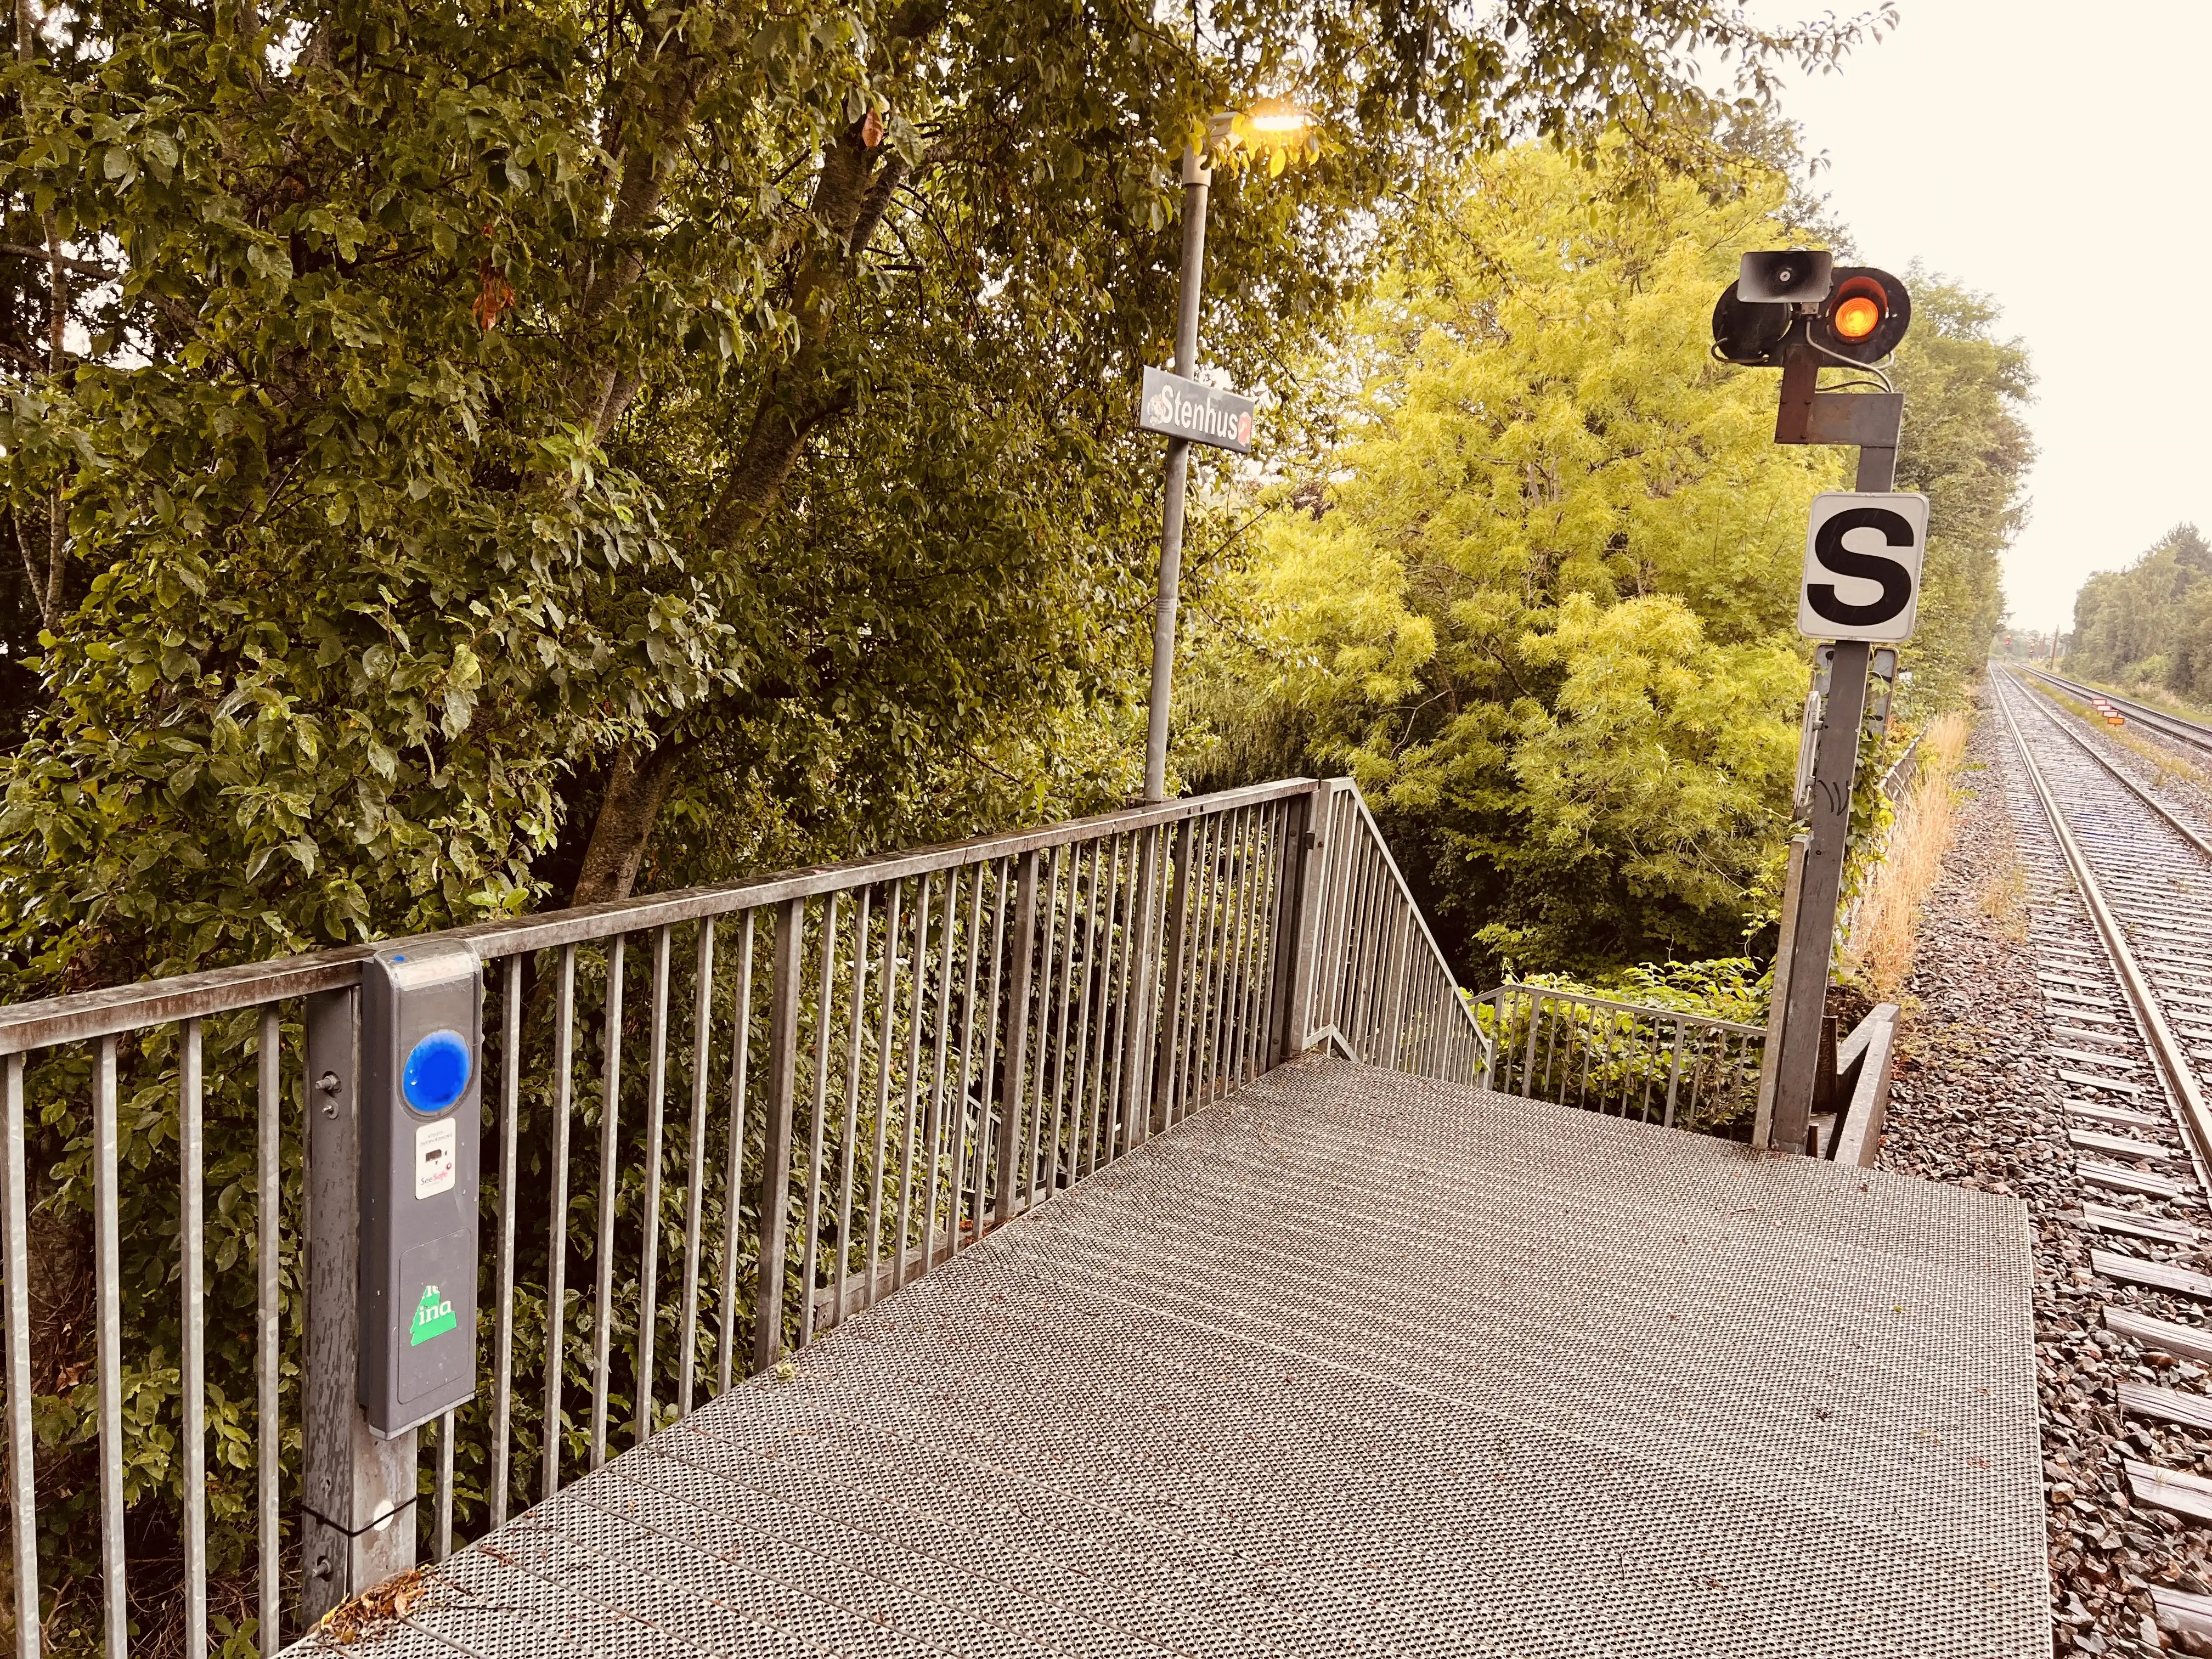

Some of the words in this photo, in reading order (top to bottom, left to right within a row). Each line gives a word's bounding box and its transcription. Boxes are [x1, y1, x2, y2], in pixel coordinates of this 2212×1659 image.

[1160, 385, 1238, 440] Stenhus
[1807, 507, 1914, 626] S
[420, 1171, 448, 1185] SeeSafe
